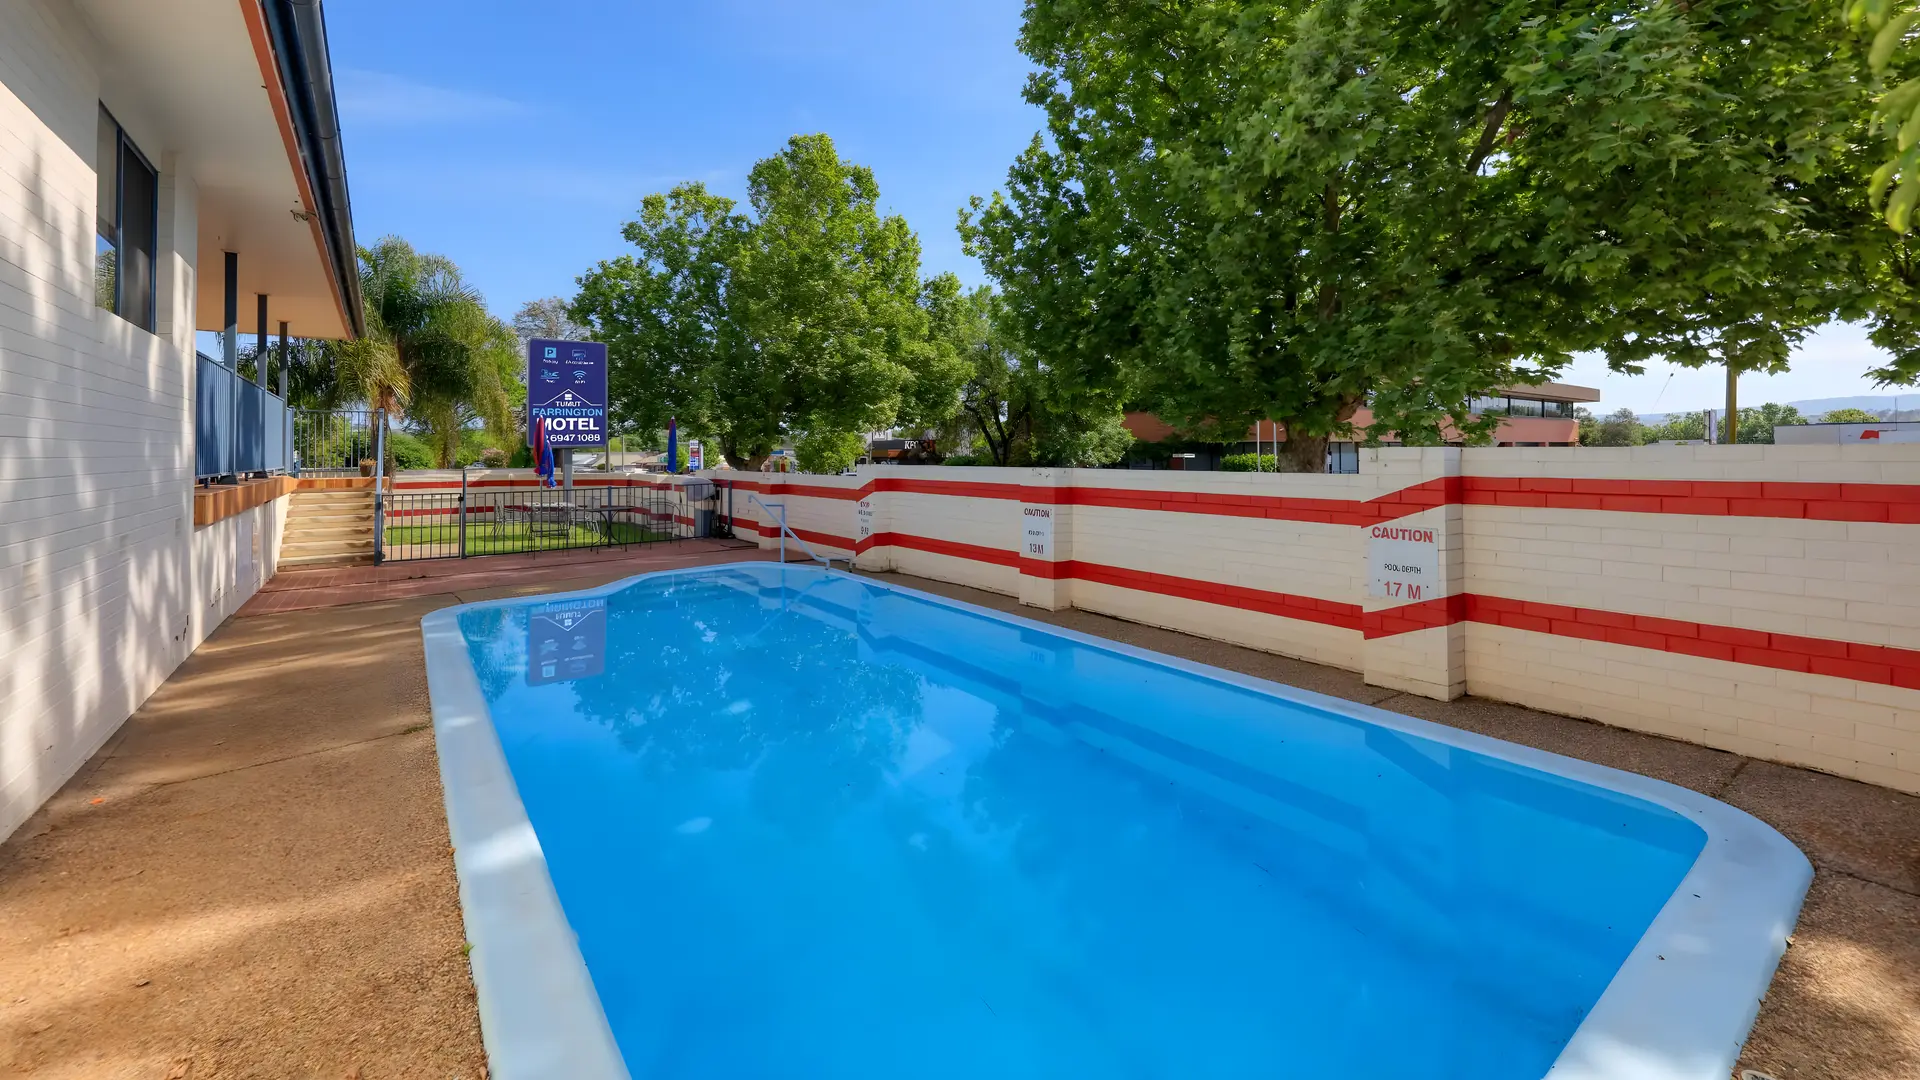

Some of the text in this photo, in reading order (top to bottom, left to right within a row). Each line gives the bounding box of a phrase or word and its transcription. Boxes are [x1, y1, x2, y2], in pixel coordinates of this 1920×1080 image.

[532, 408, 603, 416] FARRINGTON
[550, 434, 575, 442] 6947
[578, 434, 601, 442] 1088
[1372, 526, 1433, 543] CAUTION
[1384, 563, 1422, 574] POOL DEPTH
[1384, 581, 1421, 600] 1.7 M
